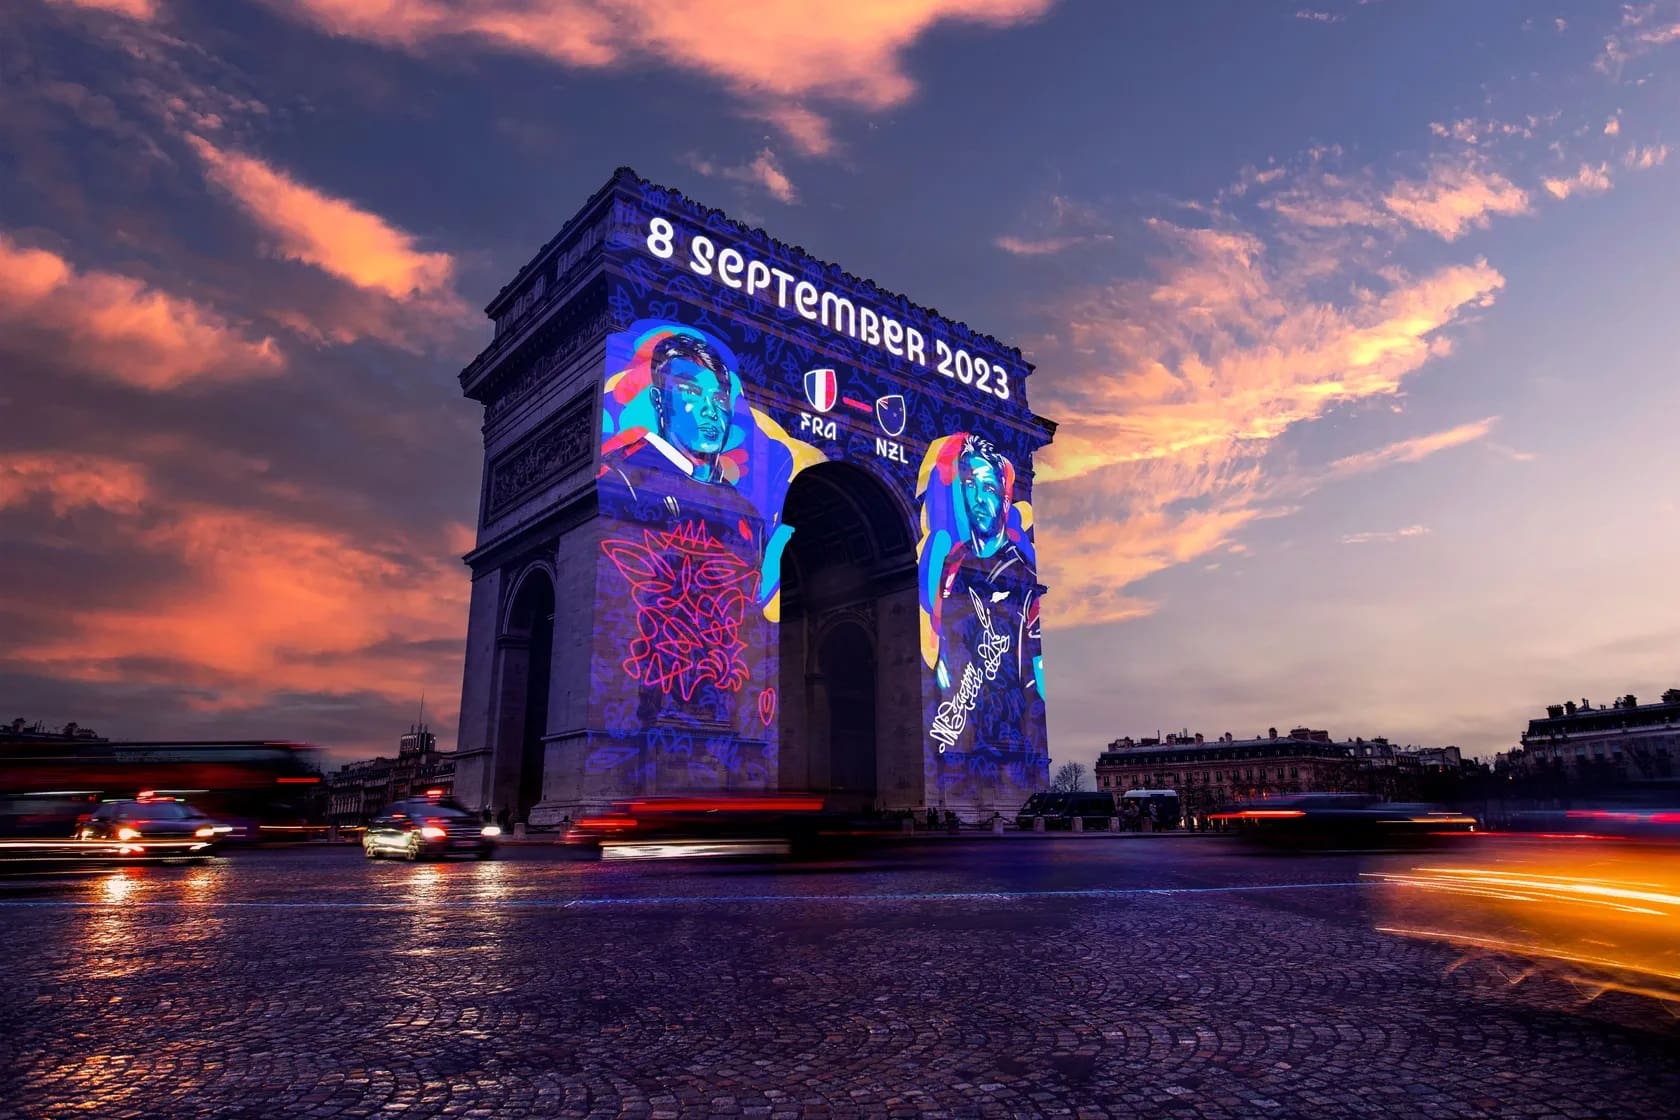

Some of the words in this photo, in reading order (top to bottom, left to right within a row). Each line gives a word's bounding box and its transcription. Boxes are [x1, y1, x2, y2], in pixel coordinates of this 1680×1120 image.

[646, 217, 674, 259] 8
[936, 339, 1011, 400] 2023
[800, 411, 837, 441] FRA
[876, 437, 909, 464] NZL
